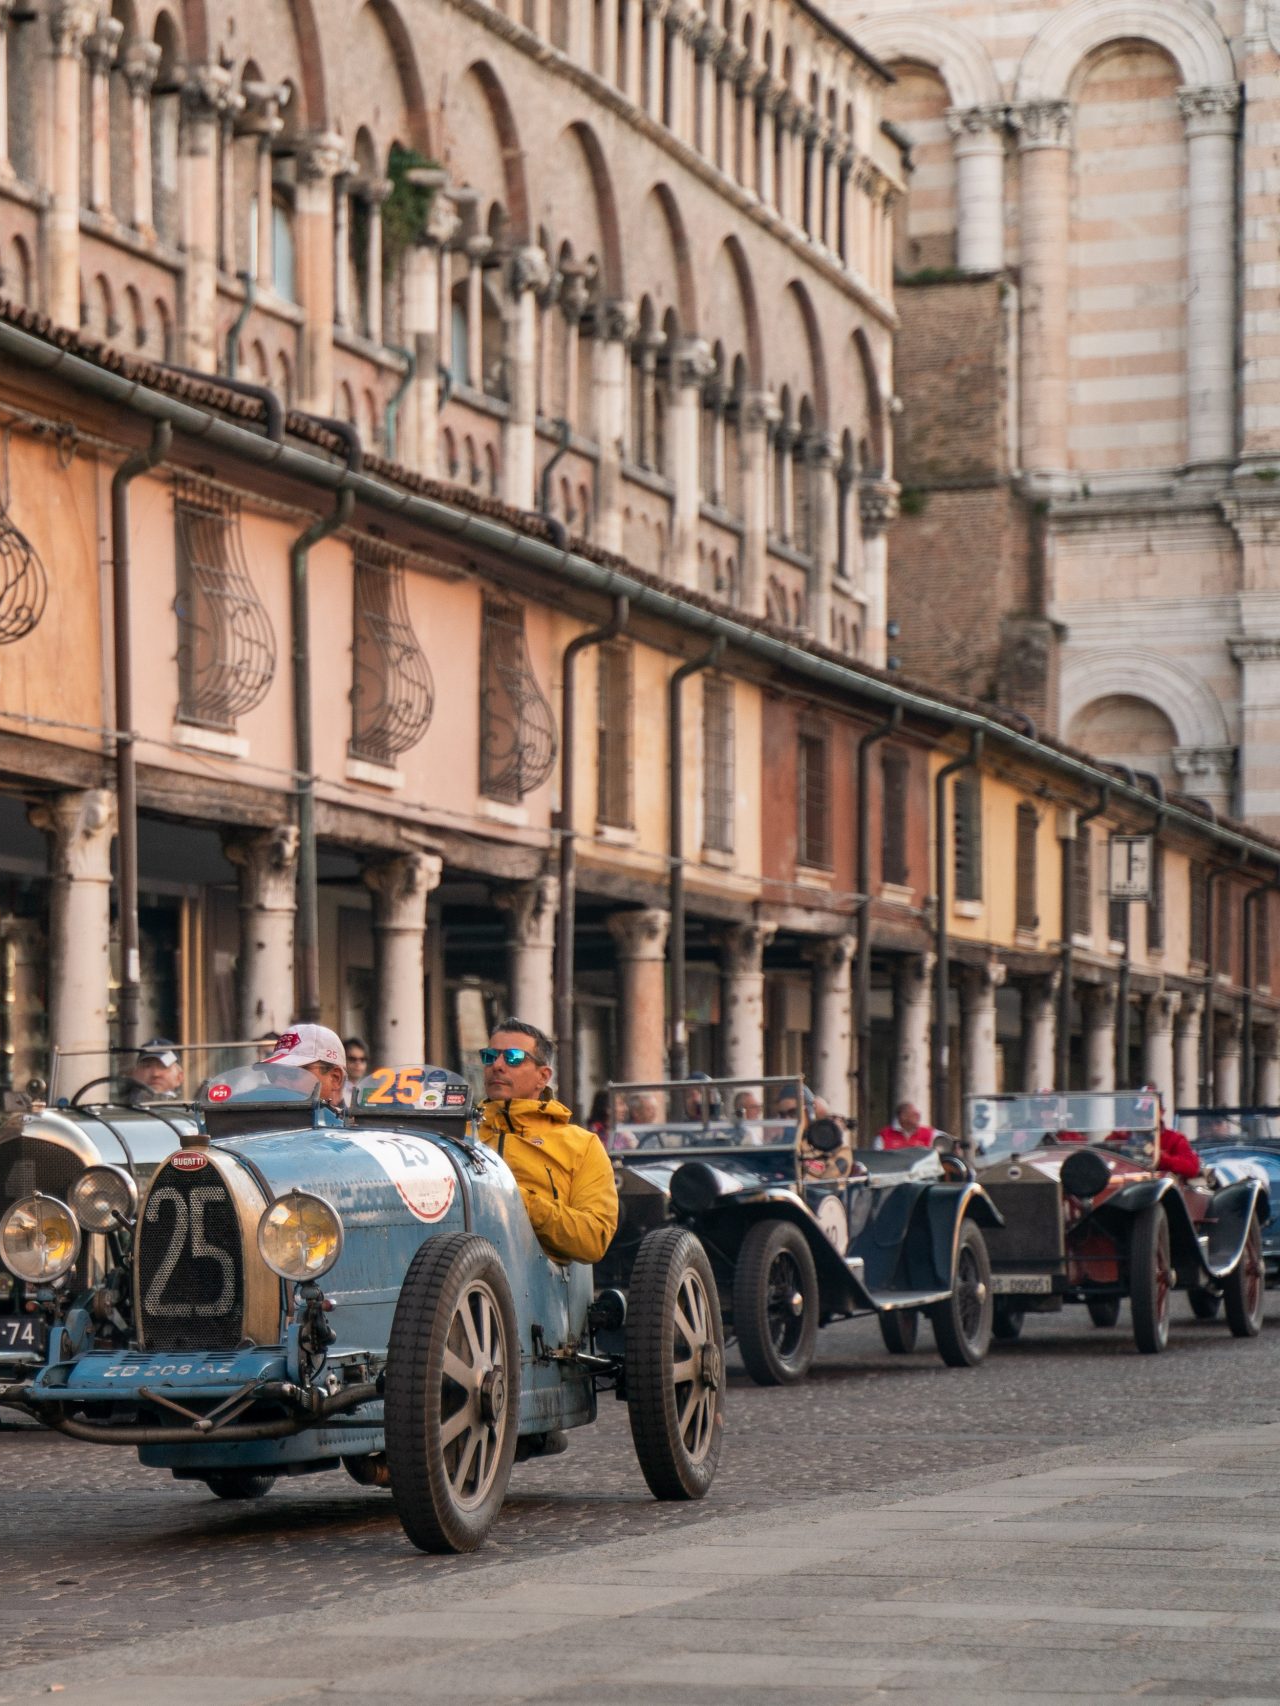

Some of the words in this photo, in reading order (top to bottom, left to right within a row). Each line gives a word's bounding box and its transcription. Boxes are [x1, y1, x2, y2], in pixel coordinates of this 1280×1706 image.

[326, 1049, 338, 1060] 25
[367, 1067, 424, 1104] 25
[173, 1157, 204, 1167] BUGATTI
[376, 1138, 430, 1168] 25
[145, 1186, 236, 1318] 25
